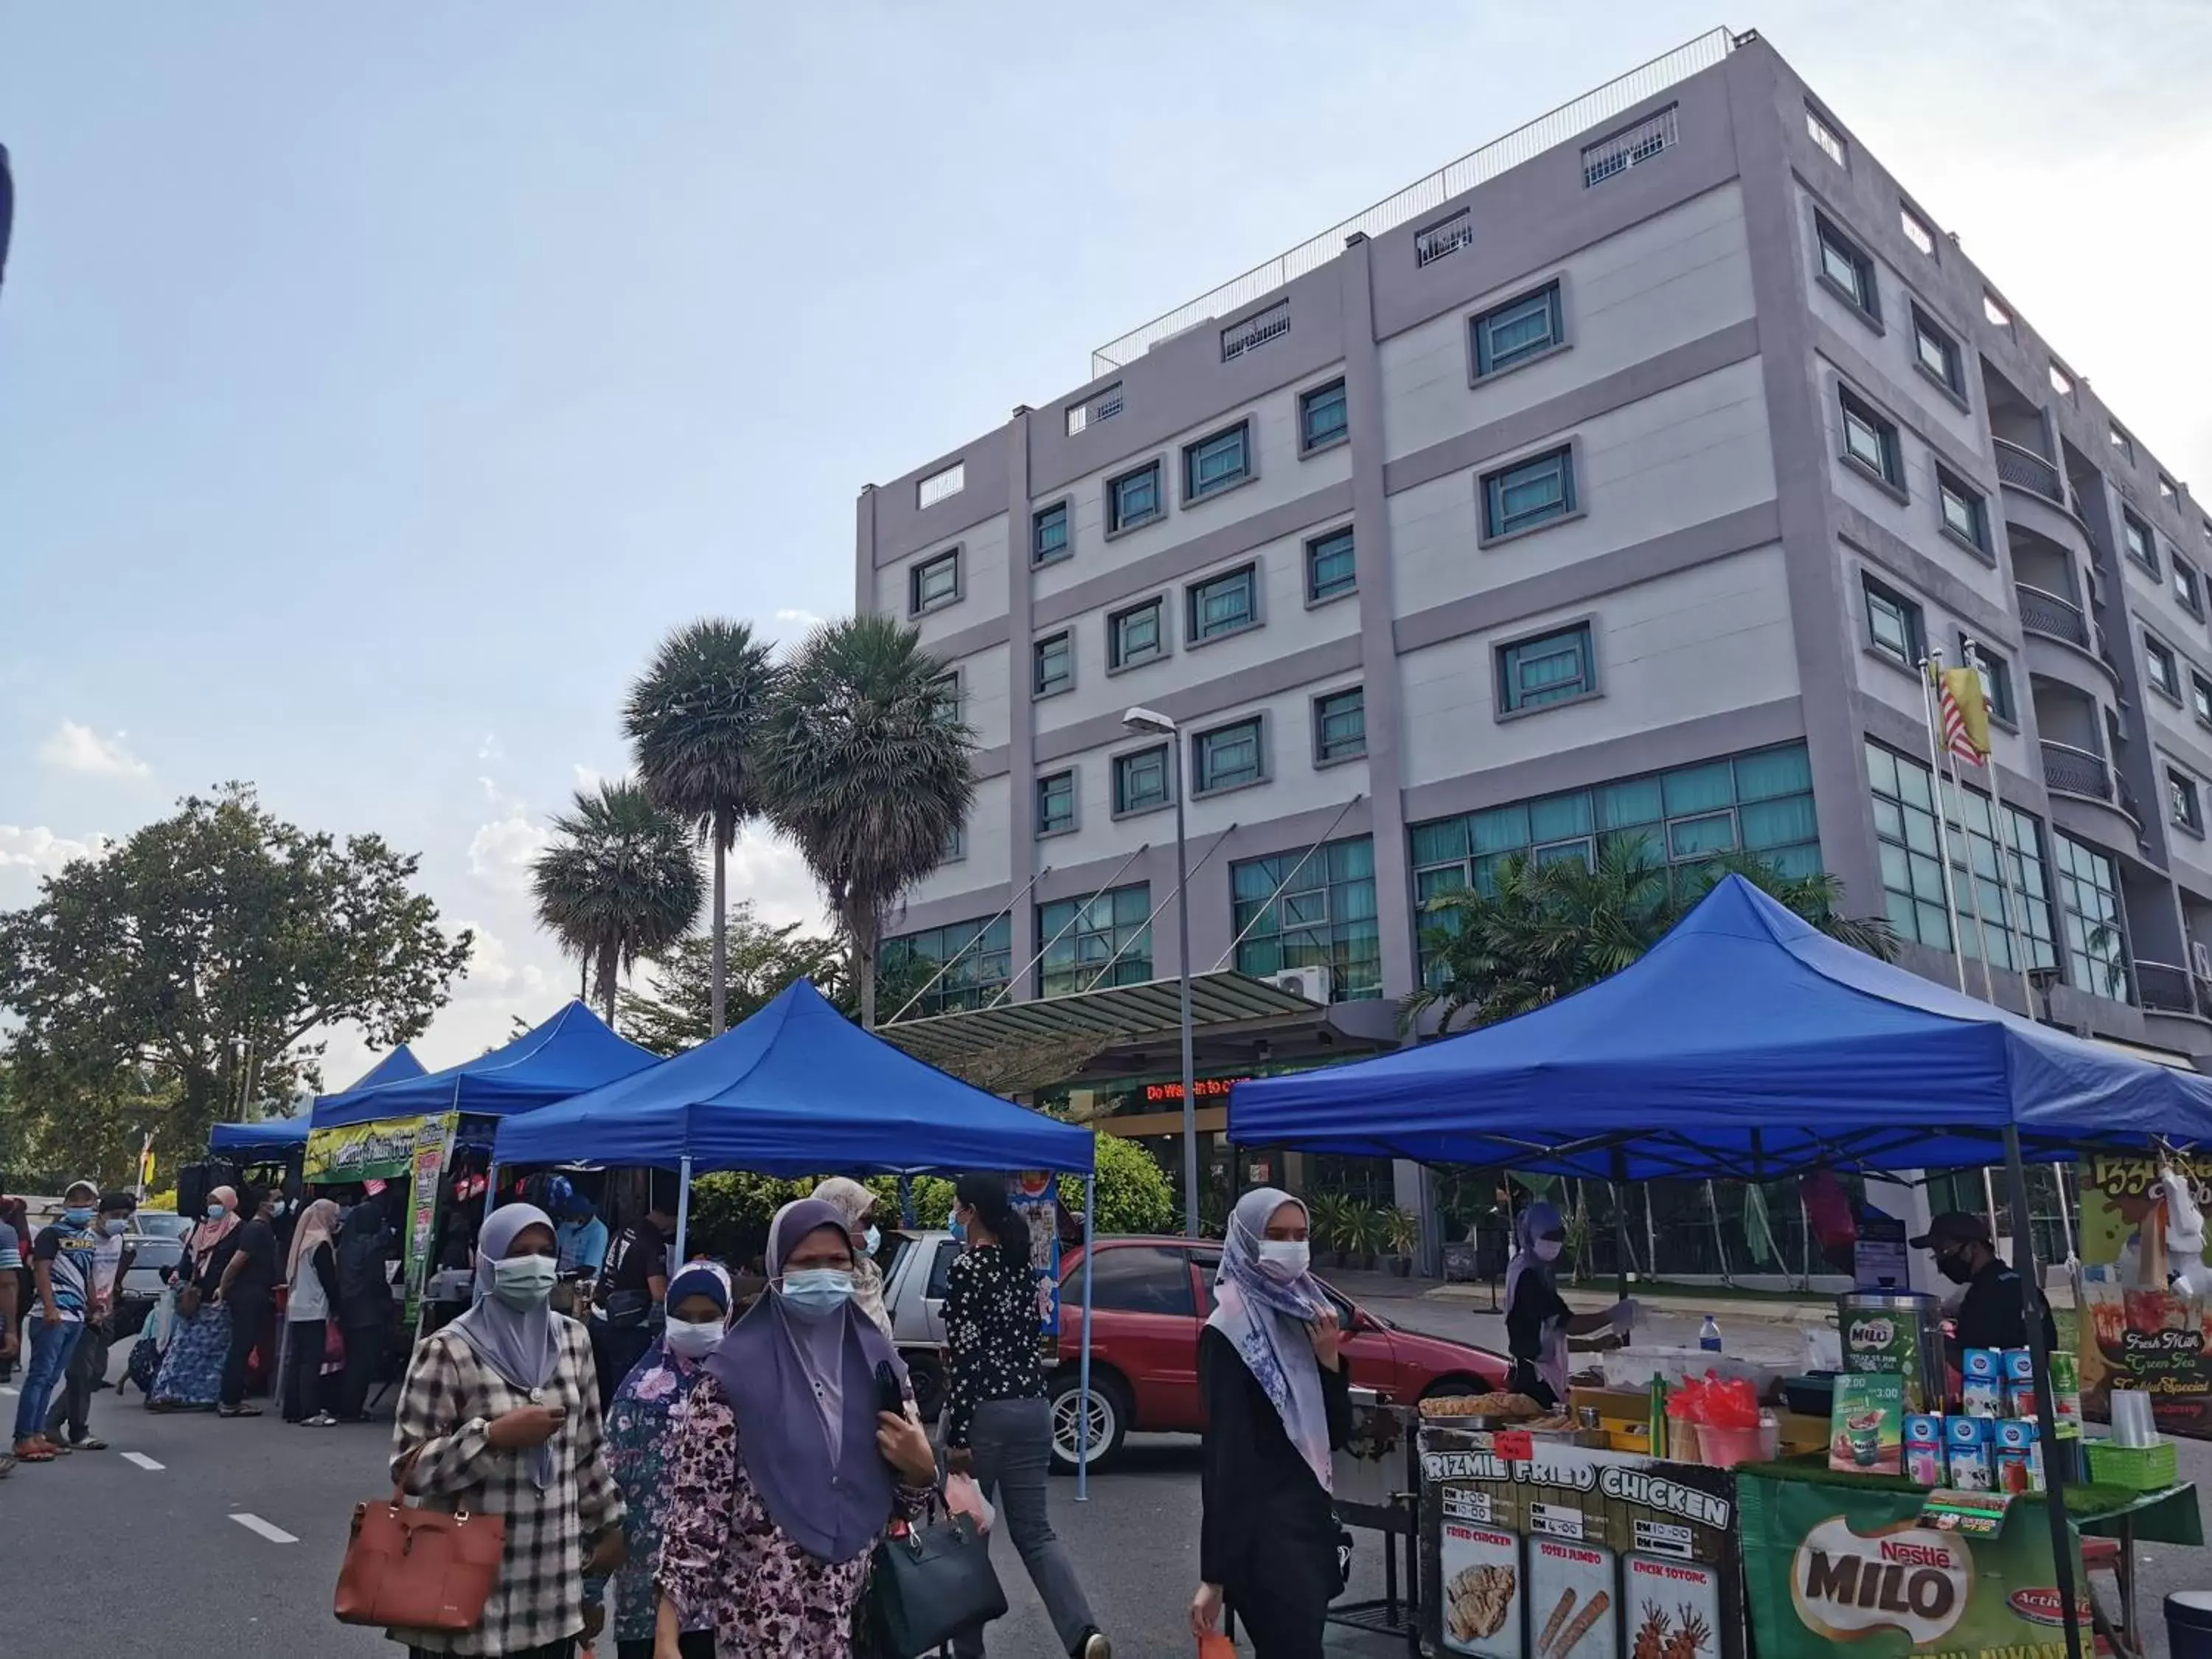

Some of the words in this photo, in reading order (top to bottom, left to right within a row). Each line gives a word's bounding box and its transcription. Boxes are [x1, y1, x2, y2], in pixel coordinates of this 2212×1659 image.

[1147, 1085, 1163, 1099] Do
[1207, 1079, 1220, 1093] to
[1851, 1328, 1888, 1342] MILO
[2124, 1333, 2161, 1349] Fresh
[2162, 1328, 2199, 1349] Milk
[2124, 1353, 2170, 1375] Green
[2171, 1352, 2195, 1368] Tea
[2160, 1377, 2209, 1396] Special
[1425, 1453, 1508, 1479] RIZMIE
[1514, 1459, 1593, 1489] FRIED
[1601, 1467, 1728, 1527] CHICKEN
[1532, 1504, 1545, 1514] RM
[1532, 1519, 1546, 1529] RM
[1636, 1522, 1651, 1533] RM
[1446, 1526, 1472, 1540] FRIED
[1473, 1531, 1511, 1545] CHICKEN
[1637, 1537, 1651, 1547] RM
[1568, 1548, 1601, 1564] JUMBO
[1664, 1567, 1708, 1585] SOTONG
[1806, 1551, 1955, 1618] MILO
